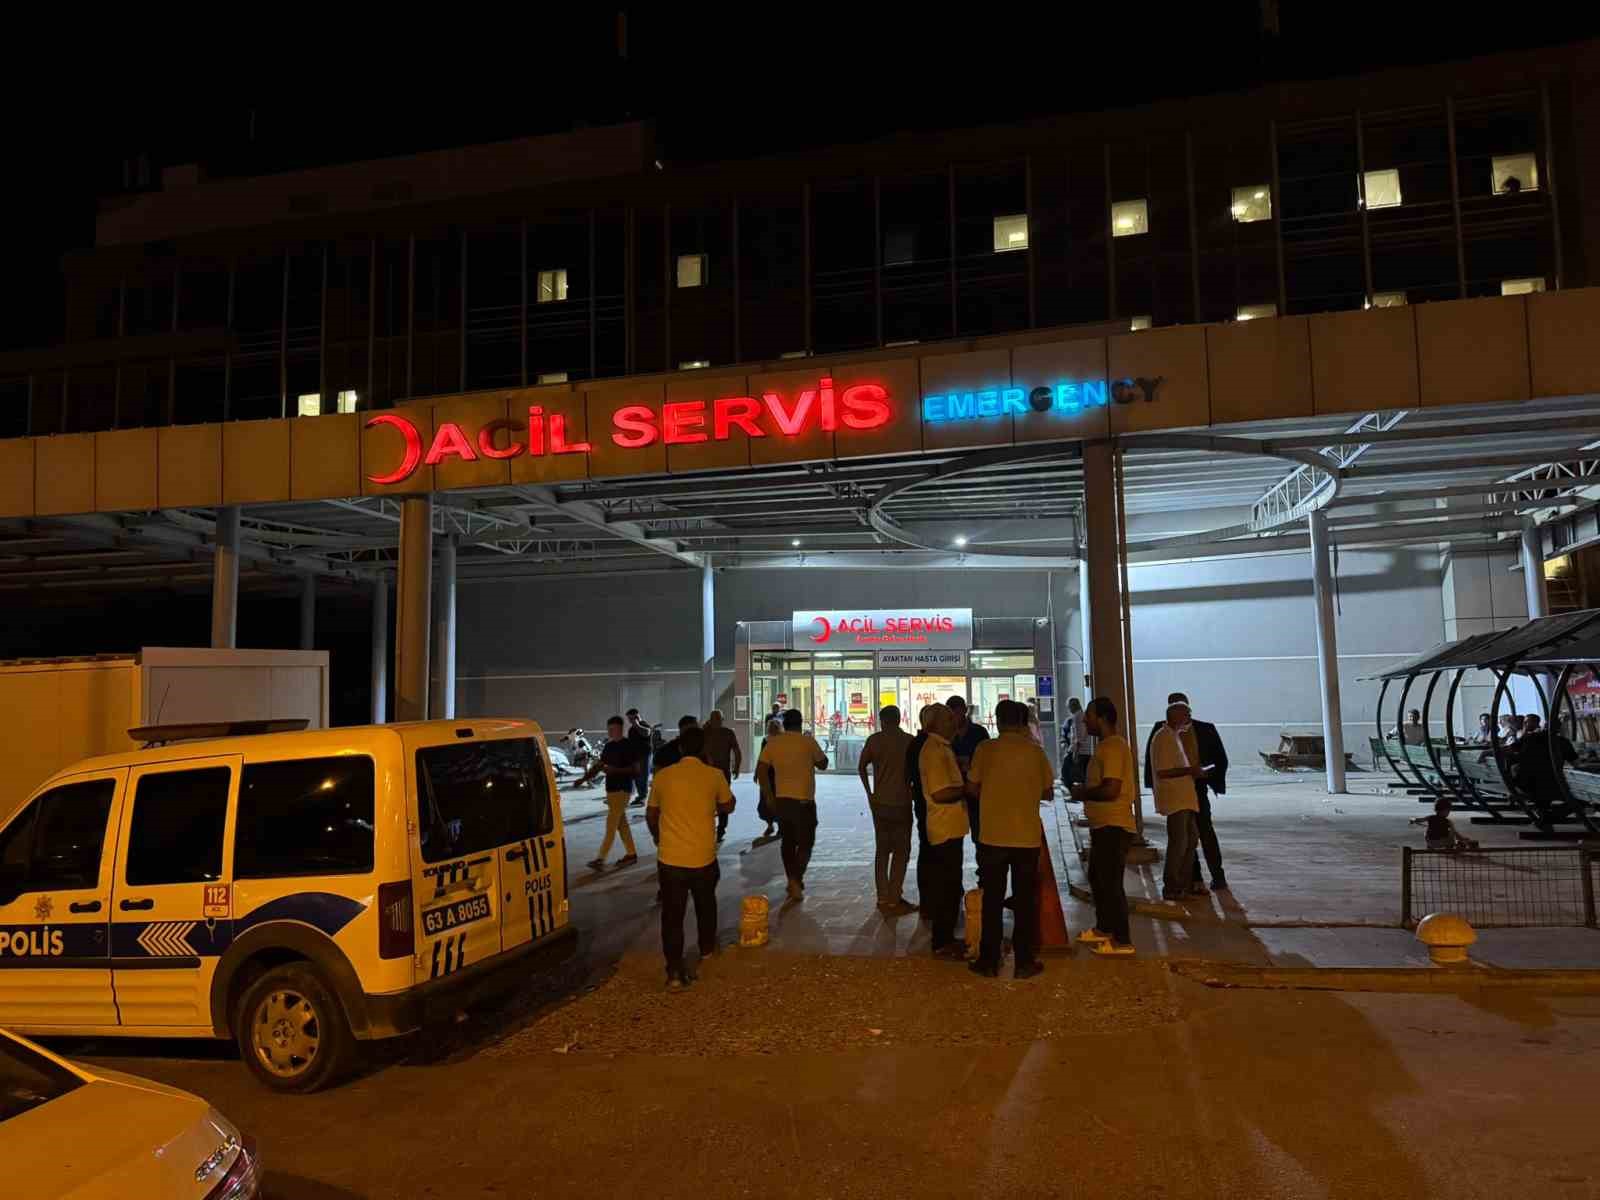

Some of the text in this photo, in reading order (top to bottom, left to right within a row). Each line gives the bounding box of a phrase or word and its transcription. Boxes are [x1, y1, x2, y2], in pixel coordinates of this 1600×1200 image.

[922, 376, 1165, 422] EMERGENCY
[425, 377, 891, 464] ACİL SERVİS
[836, 614, 954, 633] ACİL SERVİS
[207, 887, 227, 903] 112
[426, 898, 487, 931] 63 A 8055
[0, 925, 64, 956] POLİS
